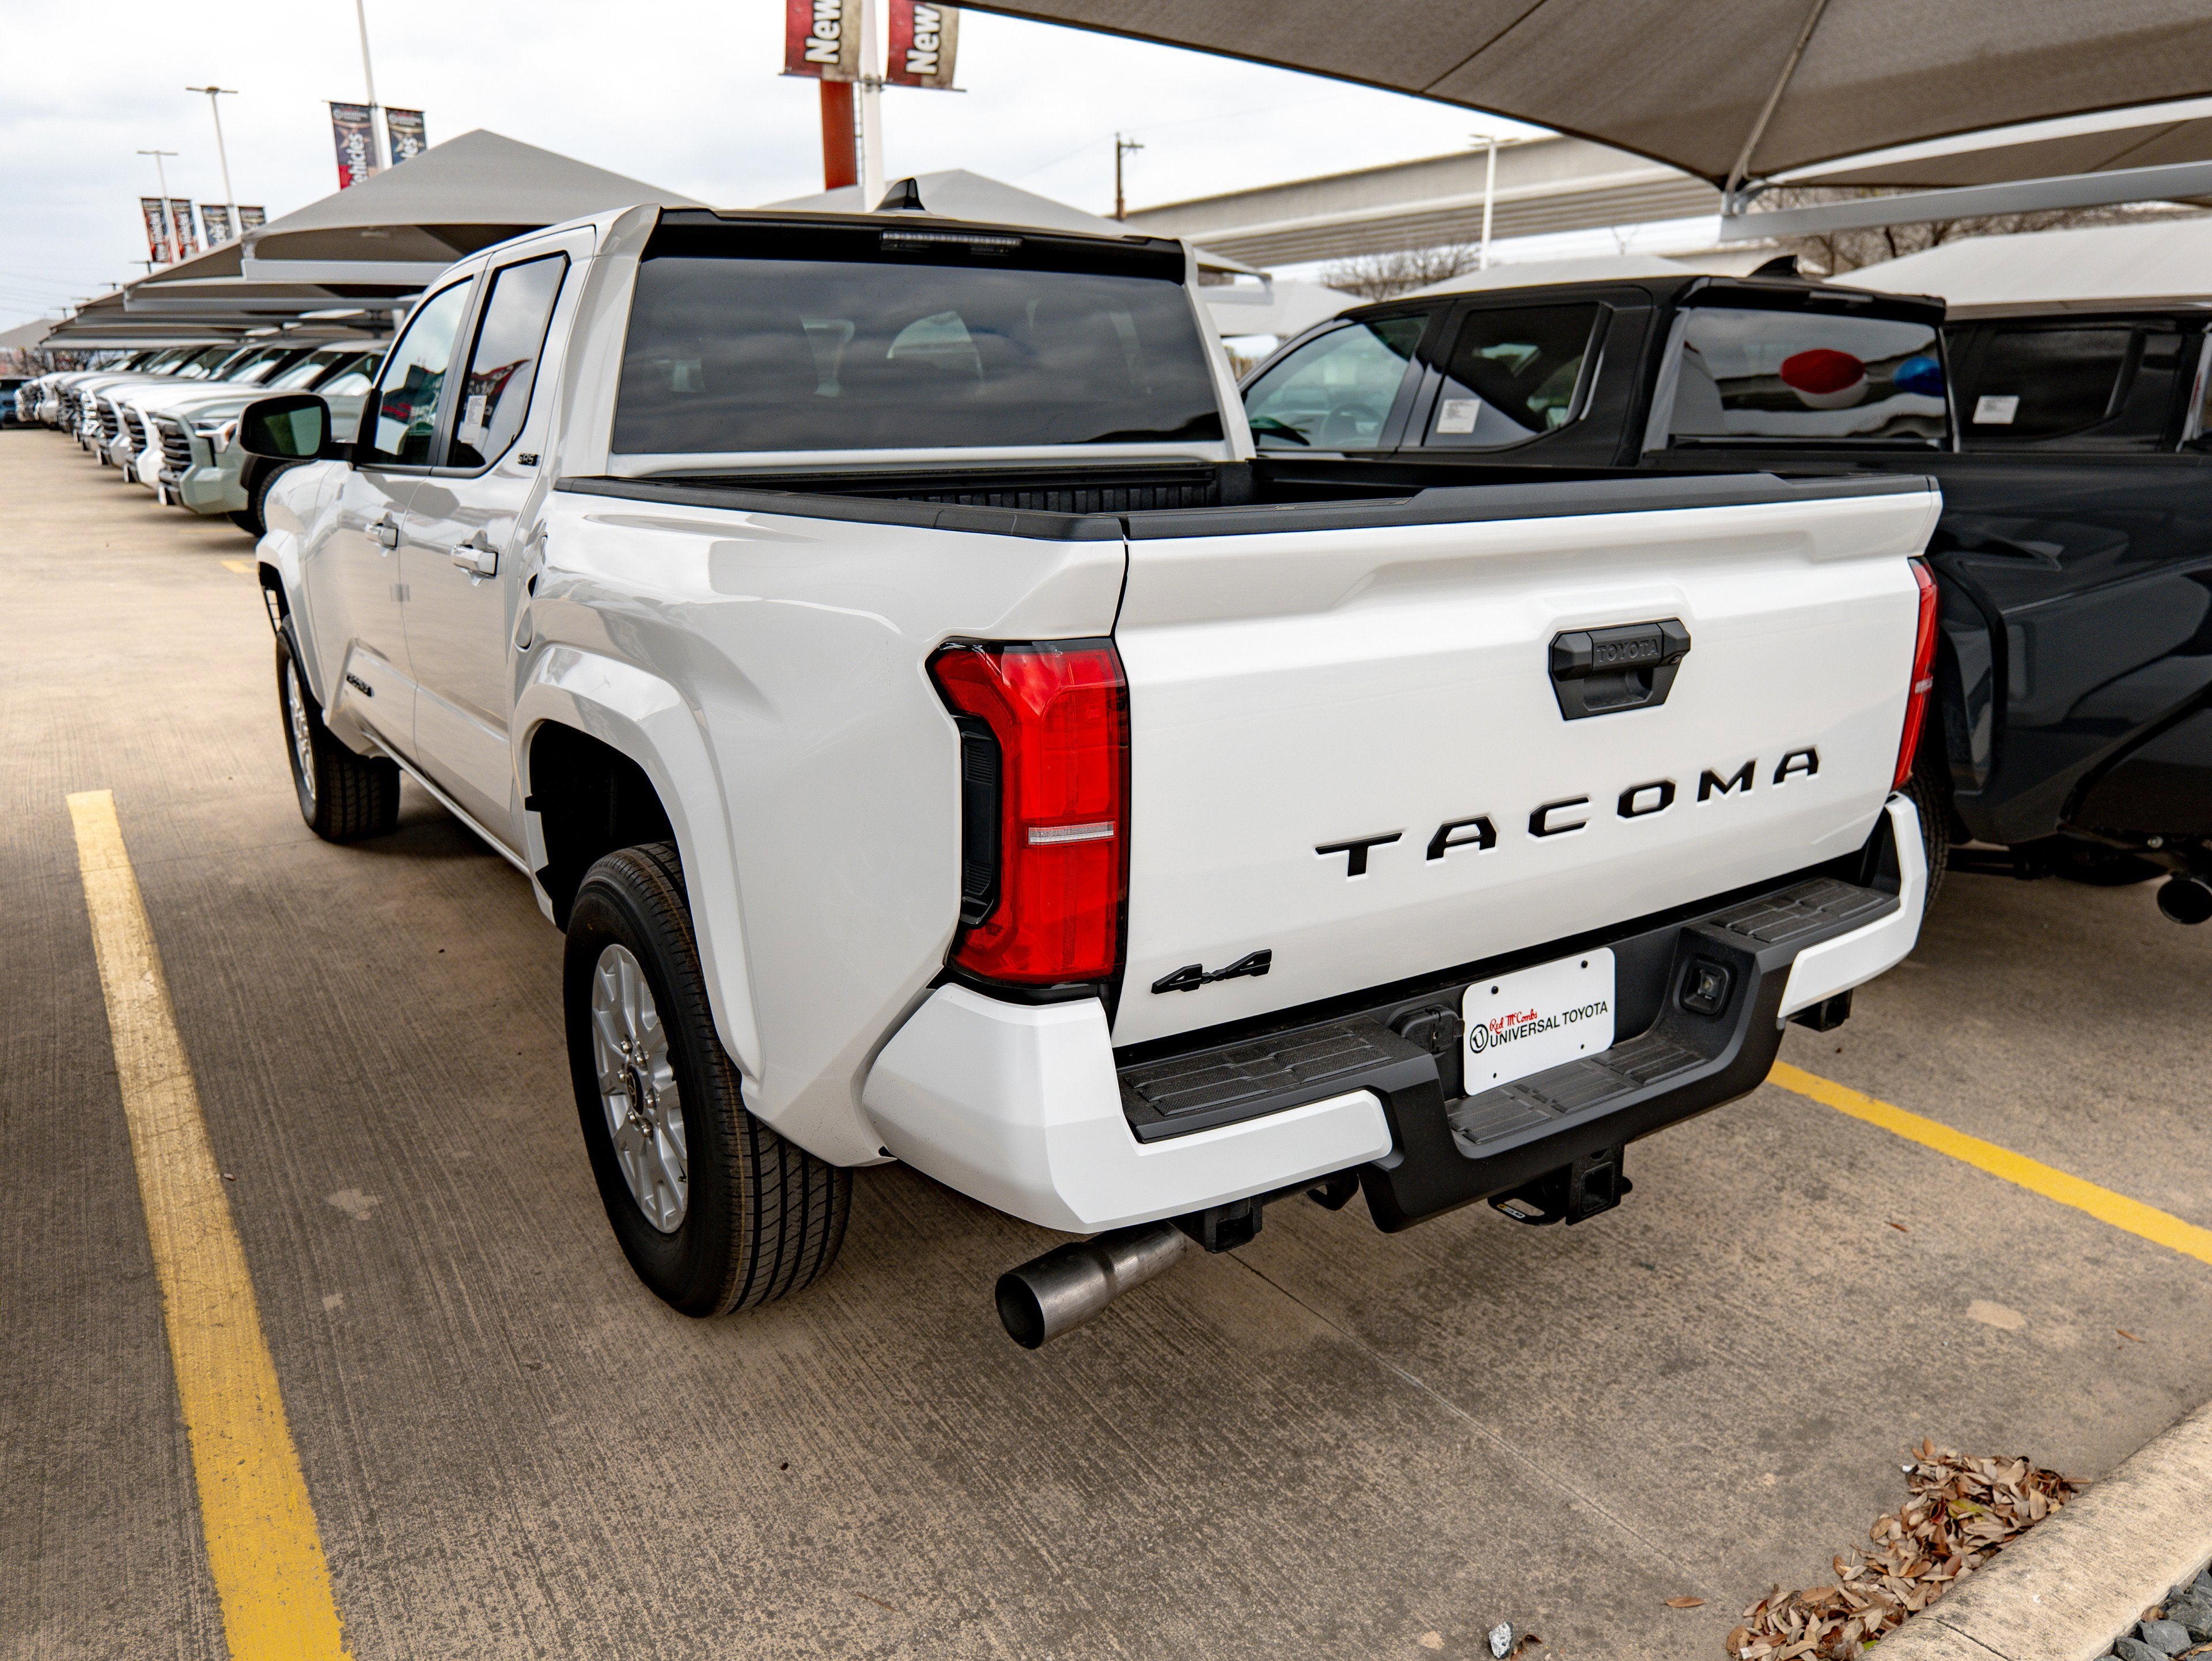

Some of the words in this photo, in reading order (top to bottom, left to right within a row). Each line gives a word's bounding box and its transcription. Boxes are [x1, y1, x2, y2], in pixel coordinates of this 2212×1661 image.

[805, 0, 840, 63] New
[906, 4, 940, 74] New
[346, 133, 368, 185] ehicles
[1596, 639, 1659, 663] TOYOTA
[1315, 747, 1819, 877] TACOMA
[1490, 1015, 1560, 1047] UNIVERSAL
[1562, 1001, 1608, 1025] TOYOTA
[1490, 1017, 1503, 1034] Red
